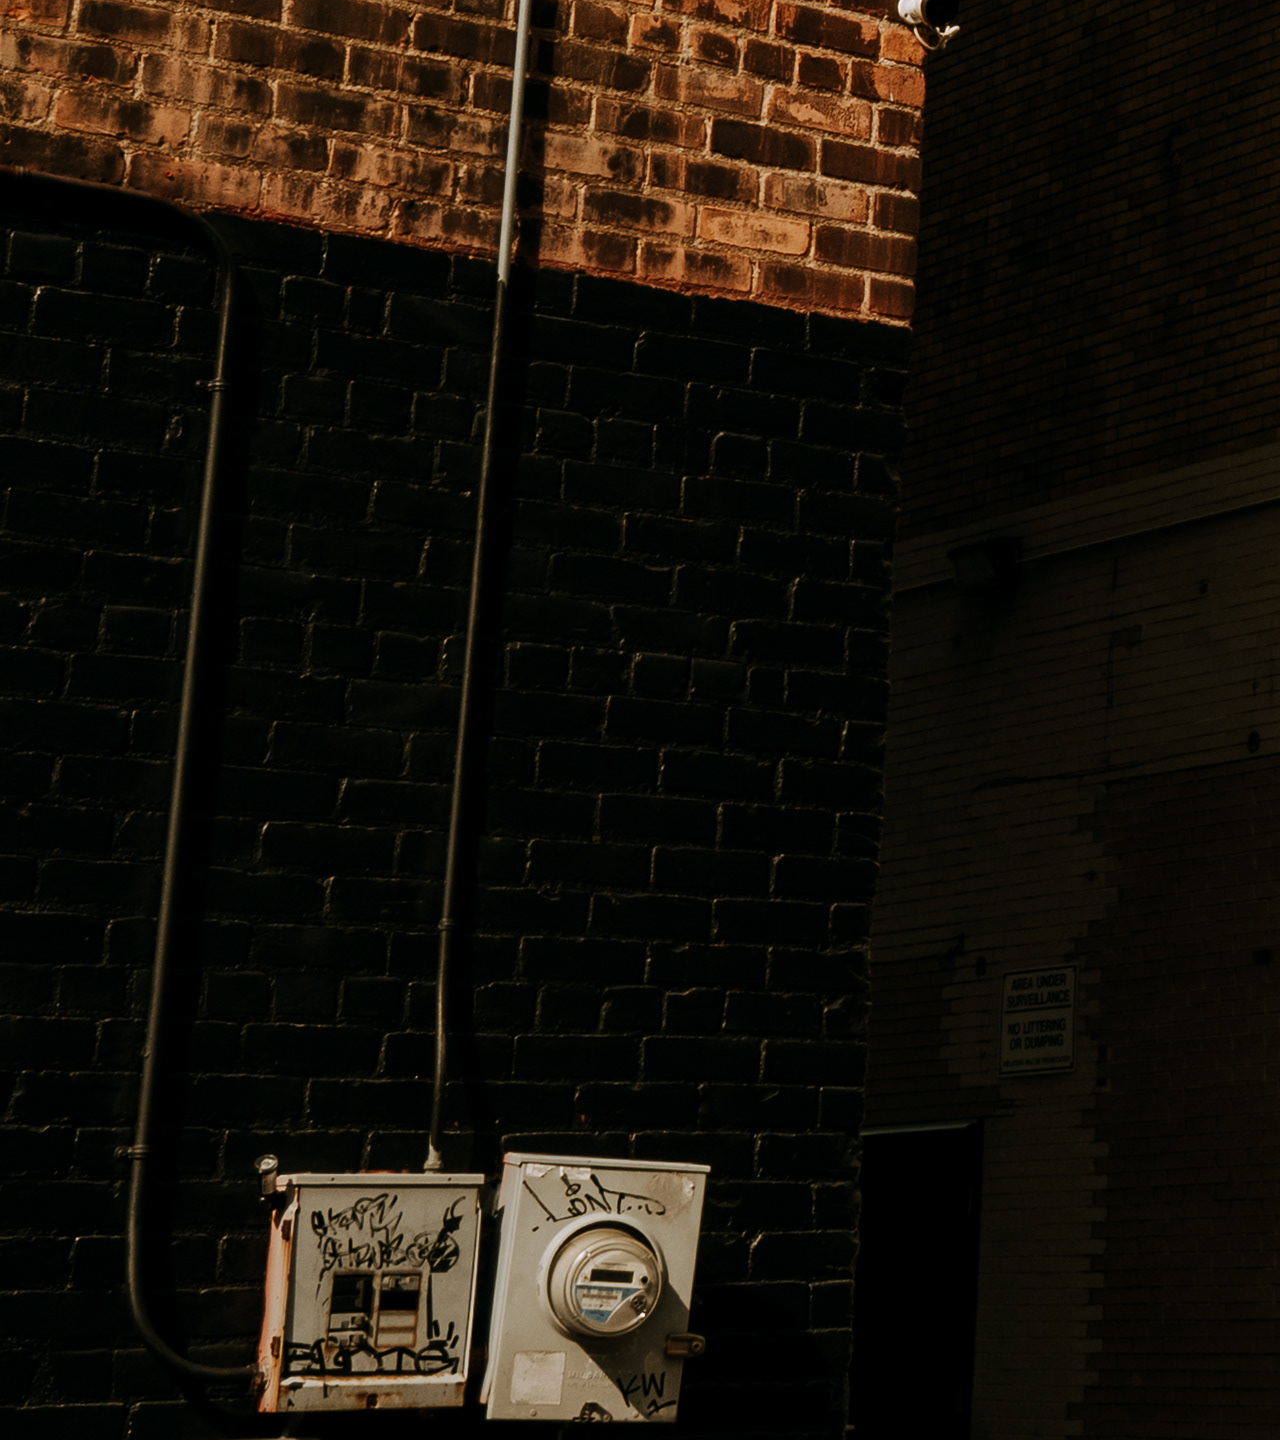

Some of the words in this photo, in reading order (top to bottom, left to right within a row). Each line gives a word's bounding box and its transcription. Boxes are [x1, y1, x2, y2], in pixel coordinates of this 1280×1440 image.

[1036, 974, 1066, 988] UNDER
[1008, 1022, 1020, 1036] NO
[1010, 1038, 1022, 1050] OR
